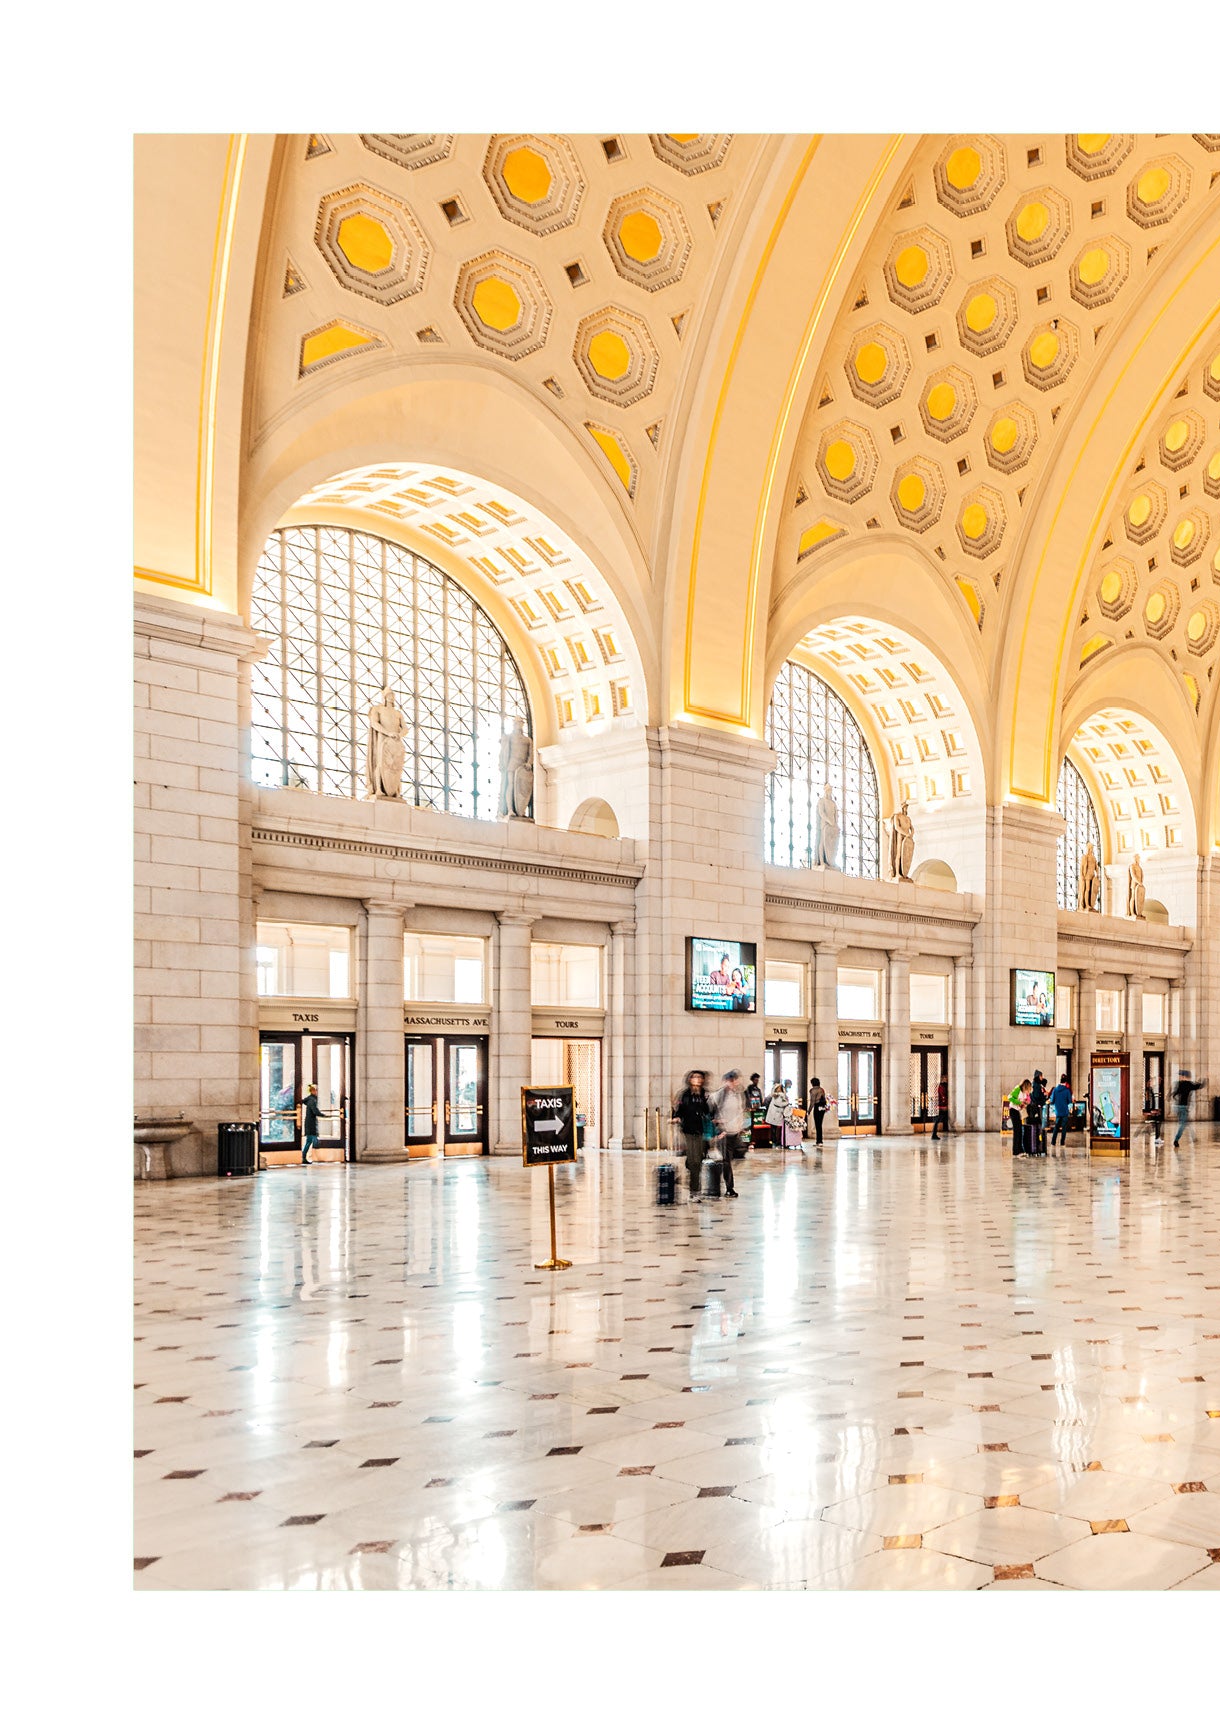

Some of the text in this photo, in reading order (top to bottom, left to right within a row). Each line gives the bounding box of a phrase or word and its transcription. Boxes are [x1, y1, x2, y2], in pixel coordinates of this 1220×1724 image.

[292, 1013, 319, 1022] TAXIS
[555, 1020, 579, 1029] TOURS
[534, 1099, 563, 1109] TAXIS
[532, 1144, 568, 1155] THIS WAY
